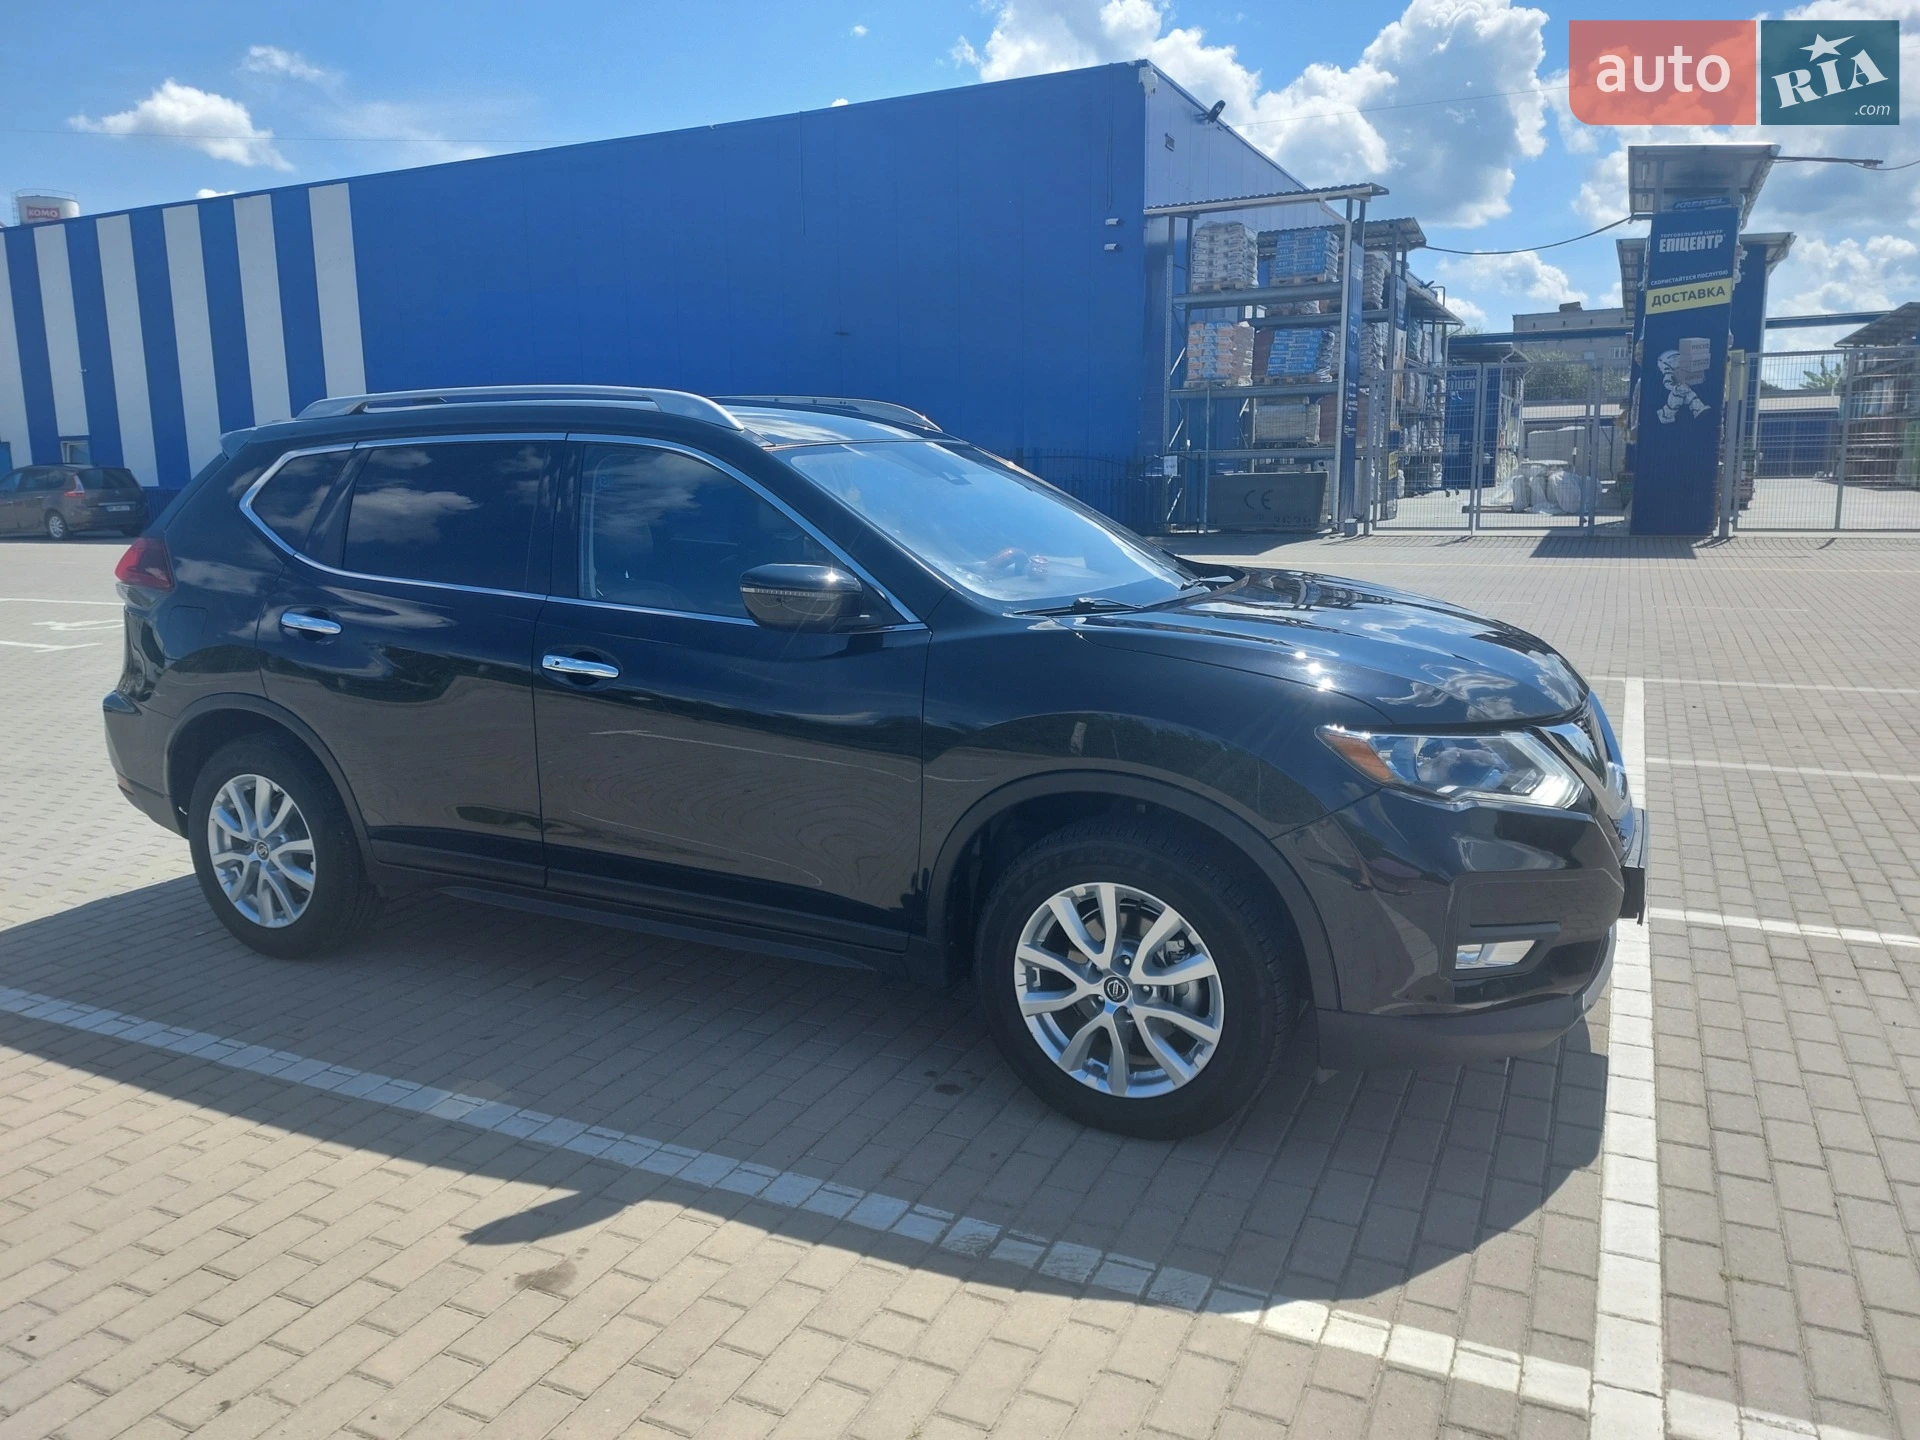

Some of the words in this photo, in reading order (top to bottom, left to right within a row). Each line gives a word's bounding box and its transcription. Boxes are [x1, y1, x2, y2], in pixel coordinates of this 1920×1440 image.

[1659, 235, 1724, 253] ЕПІЦЕНТР
[1650, 274, 1697, 286] СКОРИСТАЙТЕСЯ
[1697, 269, 1729, 279] ПОСЛУГОЮ
[1651, 285, 1726, 308] ДОСТАВКА
